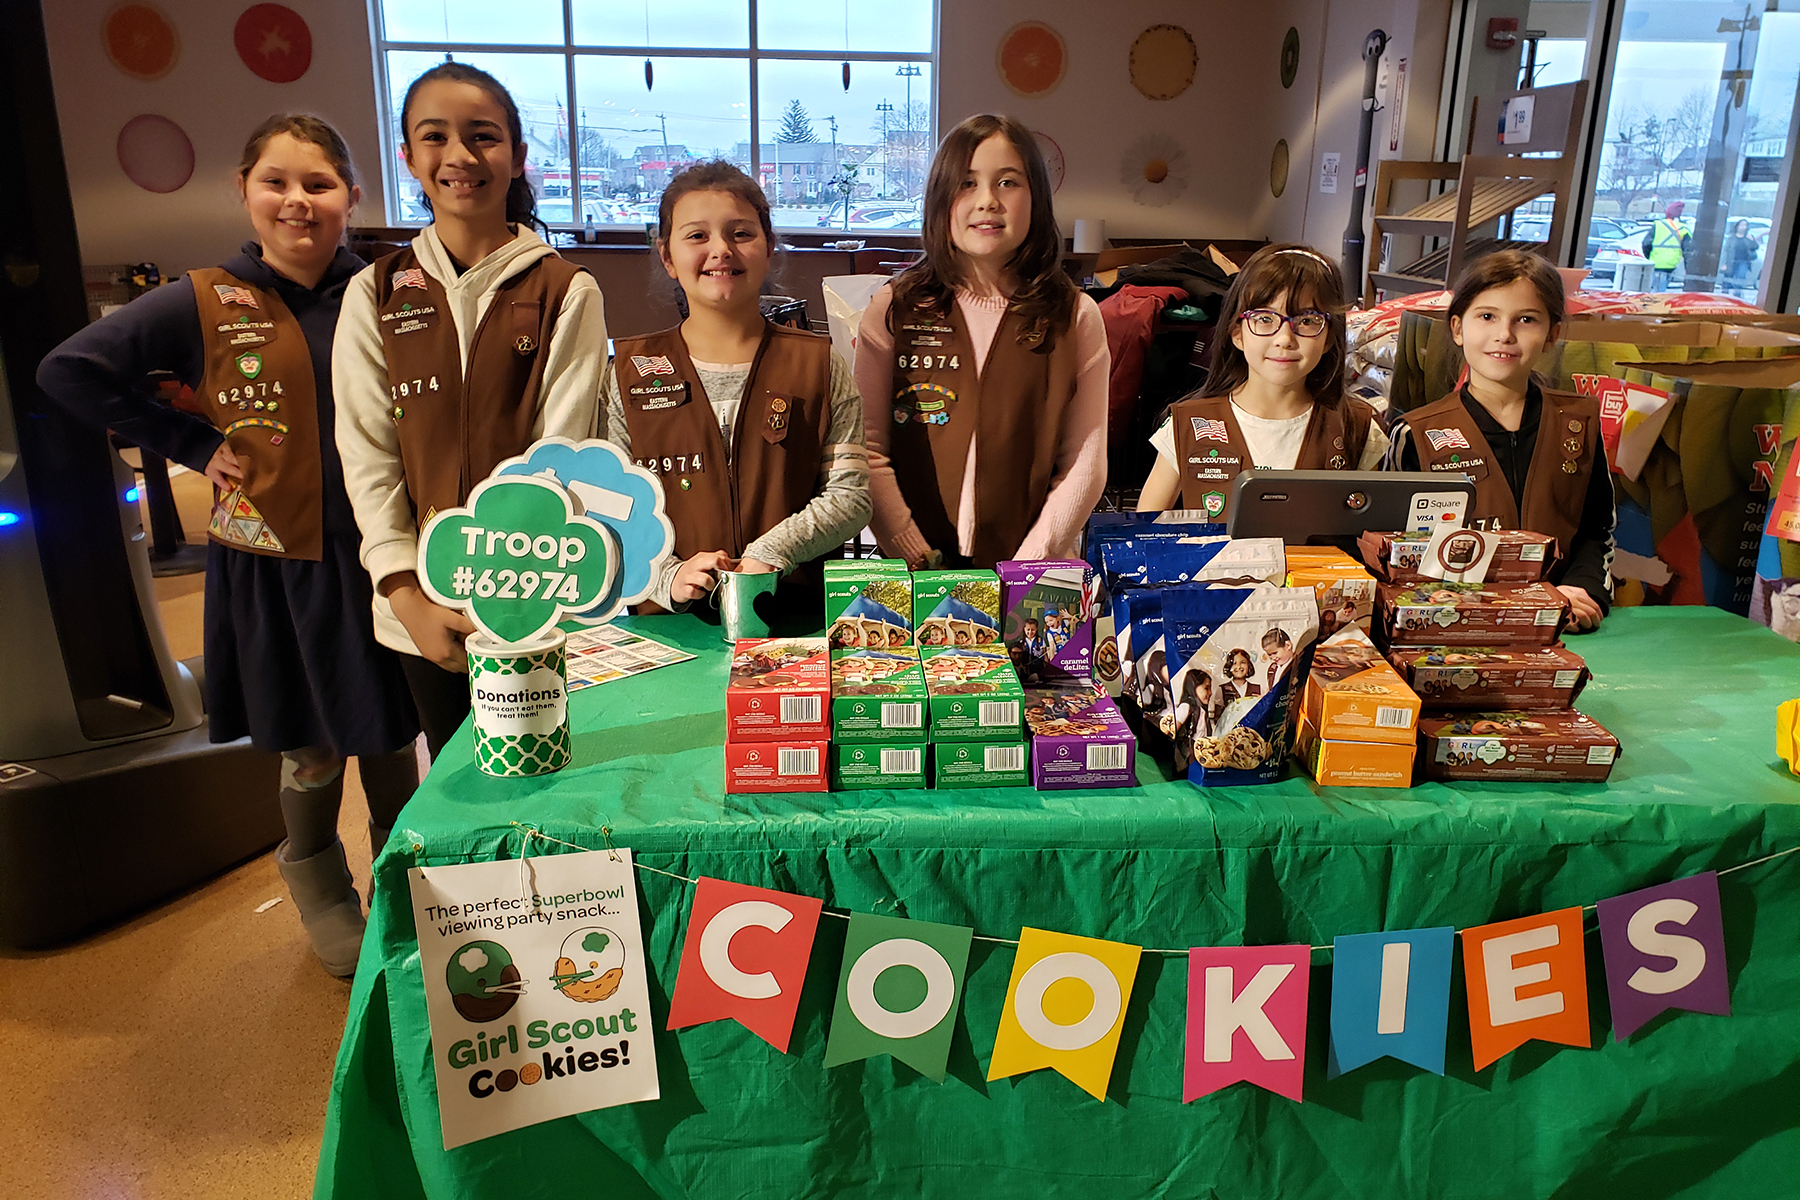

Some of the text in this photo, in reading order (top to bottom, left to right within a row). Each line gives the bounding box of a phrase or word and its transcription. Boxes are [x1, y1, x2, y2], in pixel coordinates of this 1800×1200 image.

[381, 306, 435, 322] GIRL SCOUTS USA
[232, 322, 259, 330] SCOUTS
[898, 355, 960, 370] 62974
[218, 380, 284, 405] 62974
[630, 383, 684, 396] GIRL SCOUTS USA
[1431, 458, 1484, 471] GIRL SCOUTS USA
[1430, 500, 1461, 509] Square
[461, 526, 586, 569] Troop
[452, 566, 580, 603] #62974
[1177, 633, 1186, 641] girl
[1060, 657, 1089, 665] caramel
[477, 687, 560, 703] Donations
[487, 704, 499, 713] you
[500, 704, 520, 712] can't
[534, 702, 557, 711] them,
[425, 885, 625, 921] The perfect Superbowl
[438, 903, 620, 937] viewing party snack...
[448, 1008, 638, 1070] Girl Scout
[468, 1039, 631, 1099] Cookies!
